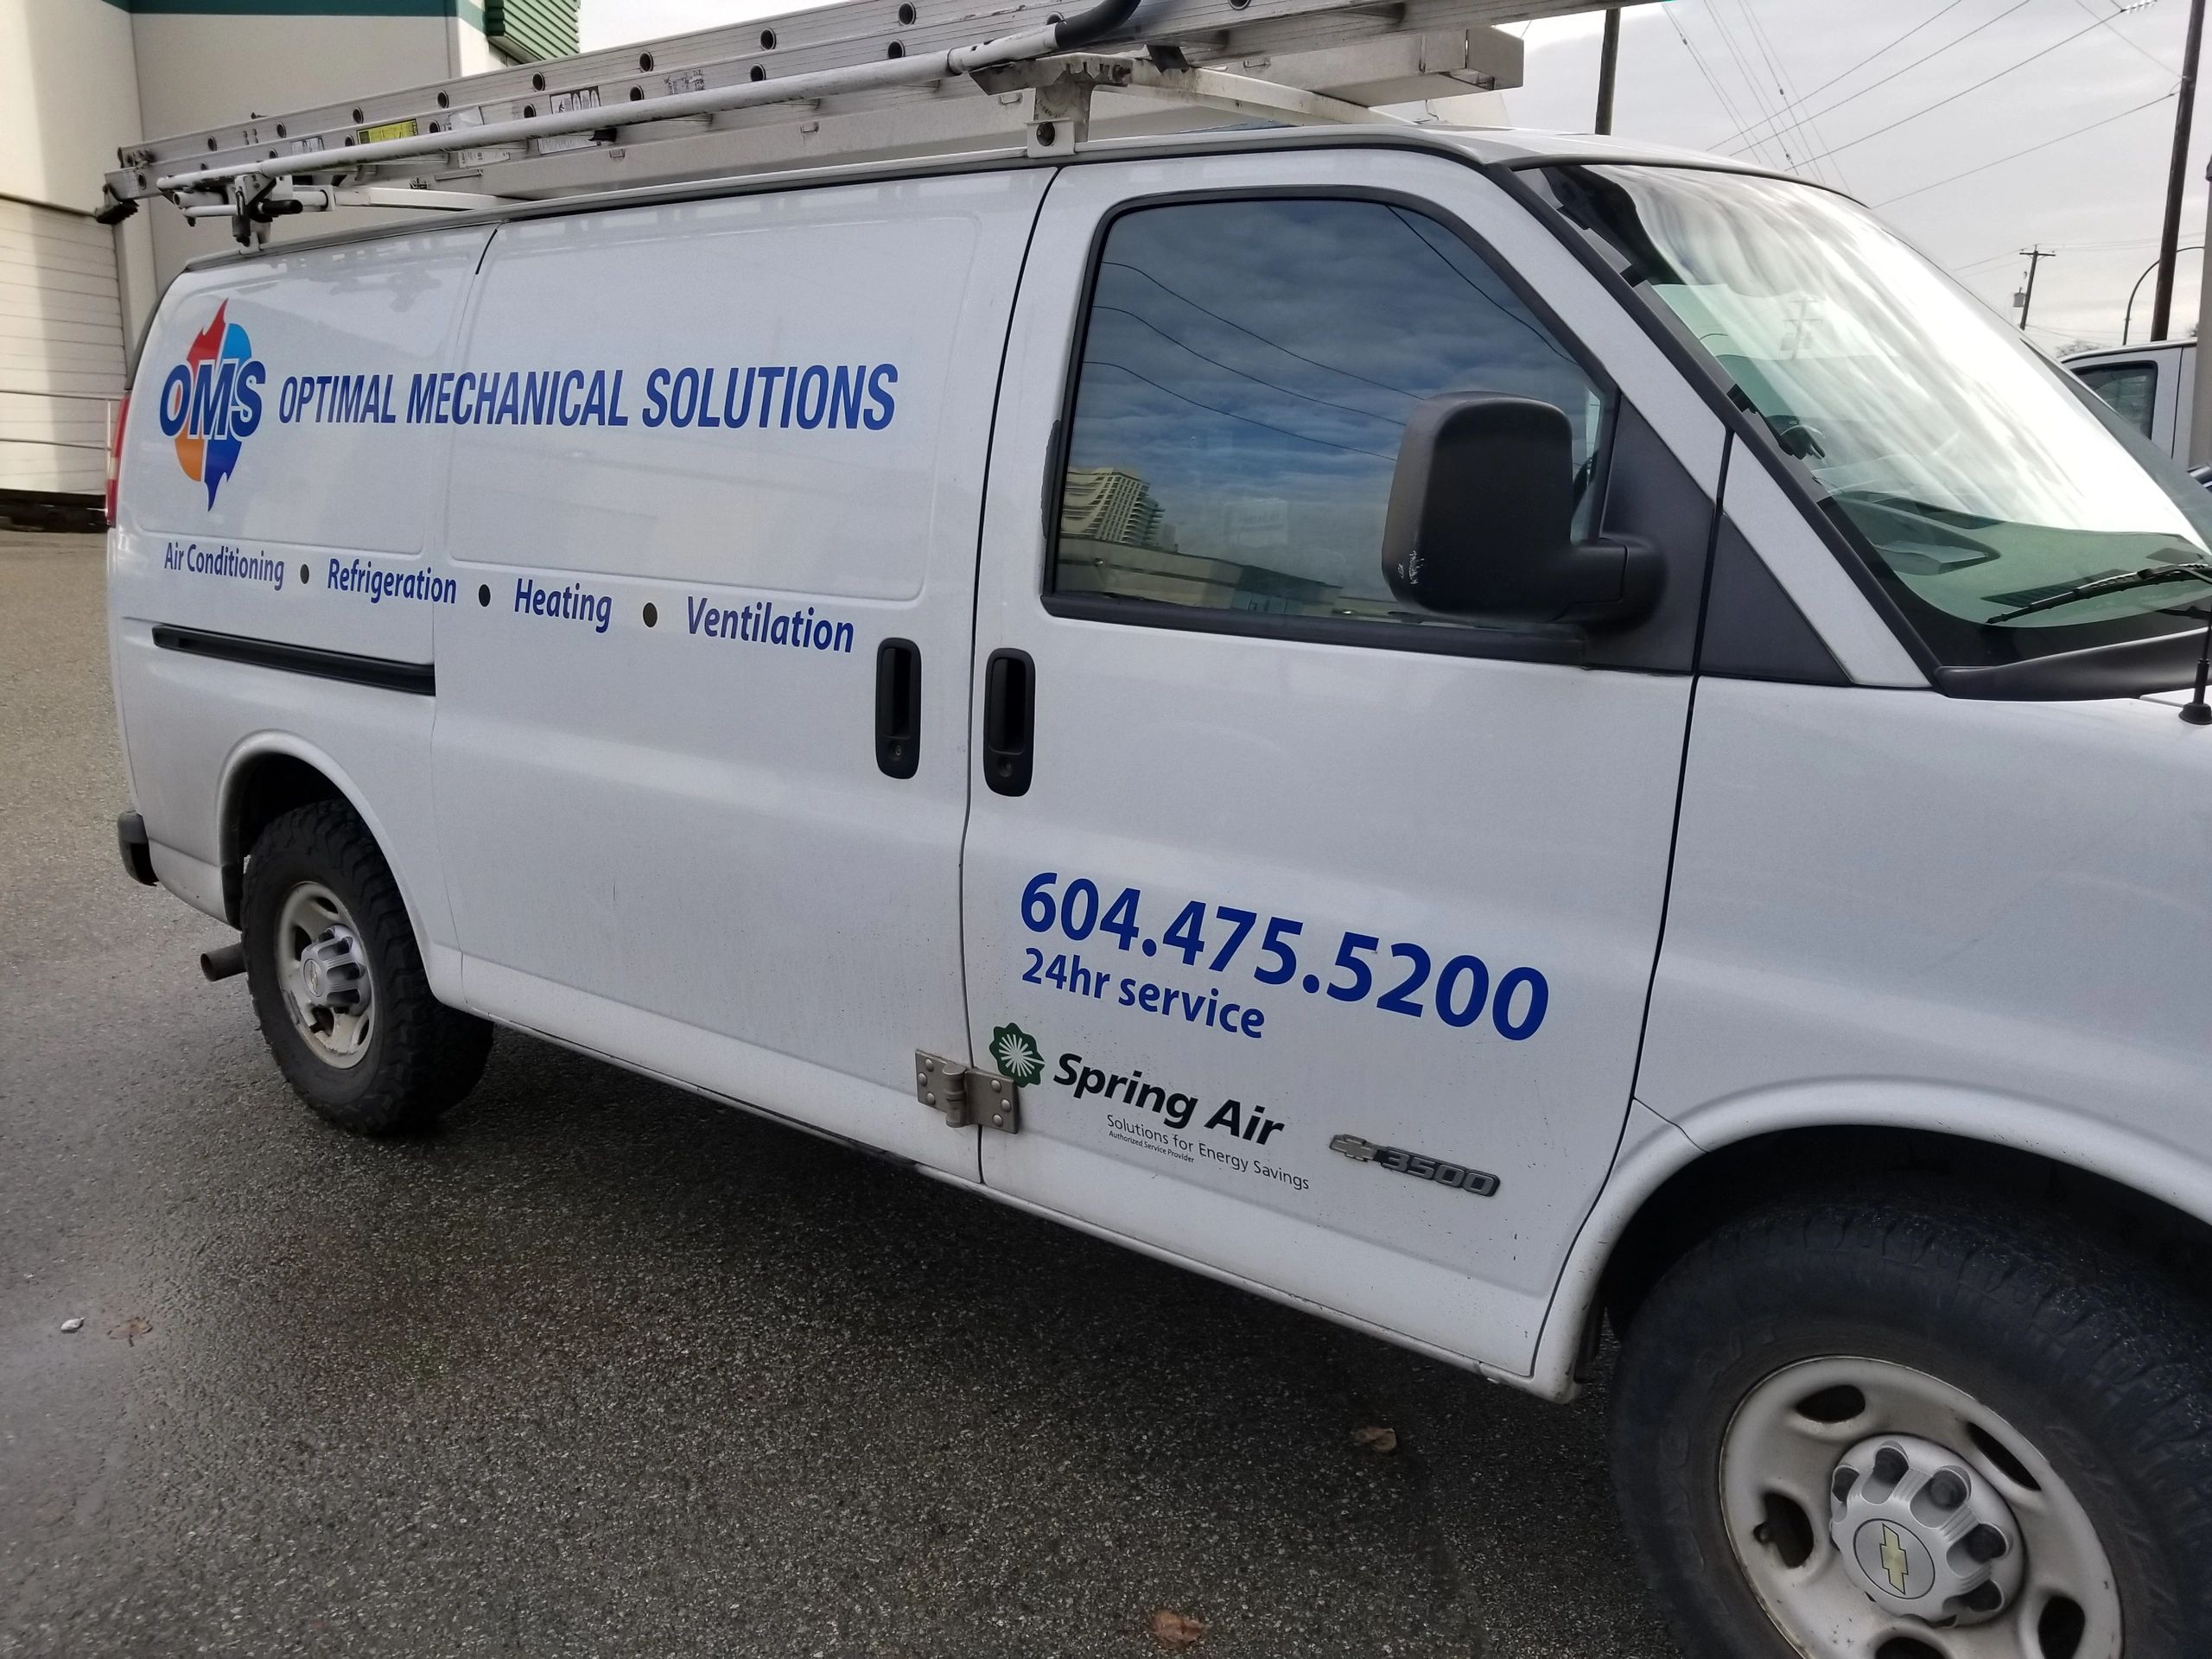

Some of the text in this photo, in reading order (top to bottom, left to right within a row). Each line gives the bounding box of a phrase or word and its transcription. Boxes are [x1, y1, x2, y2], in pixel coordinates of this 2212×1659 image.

[159, 359, 266, 437] OMS
[278, 363, 899, 430] OPTIMAL MECHANICAL SOLUTIONS
[164, 542, 284, 591] Air Conditioning
[327, 558, 457, 604] Refrigeration
[514, 578, 612, 633] Heating
[688, 596, 855, 653] Ventilation
[1020, 872, 1549, 1041] 604.475.5200
[1022, 947, 1265, 1039] 24hr service
[1053, 1052, 1286, 1146] Spring Air
[1107, 1115, 1310, 1191] Solutions for Energy Savings
[1109, 1130, 1195, 1164] Authorized Service Provider
[1382, 1149, 1495, 1197] 3500
